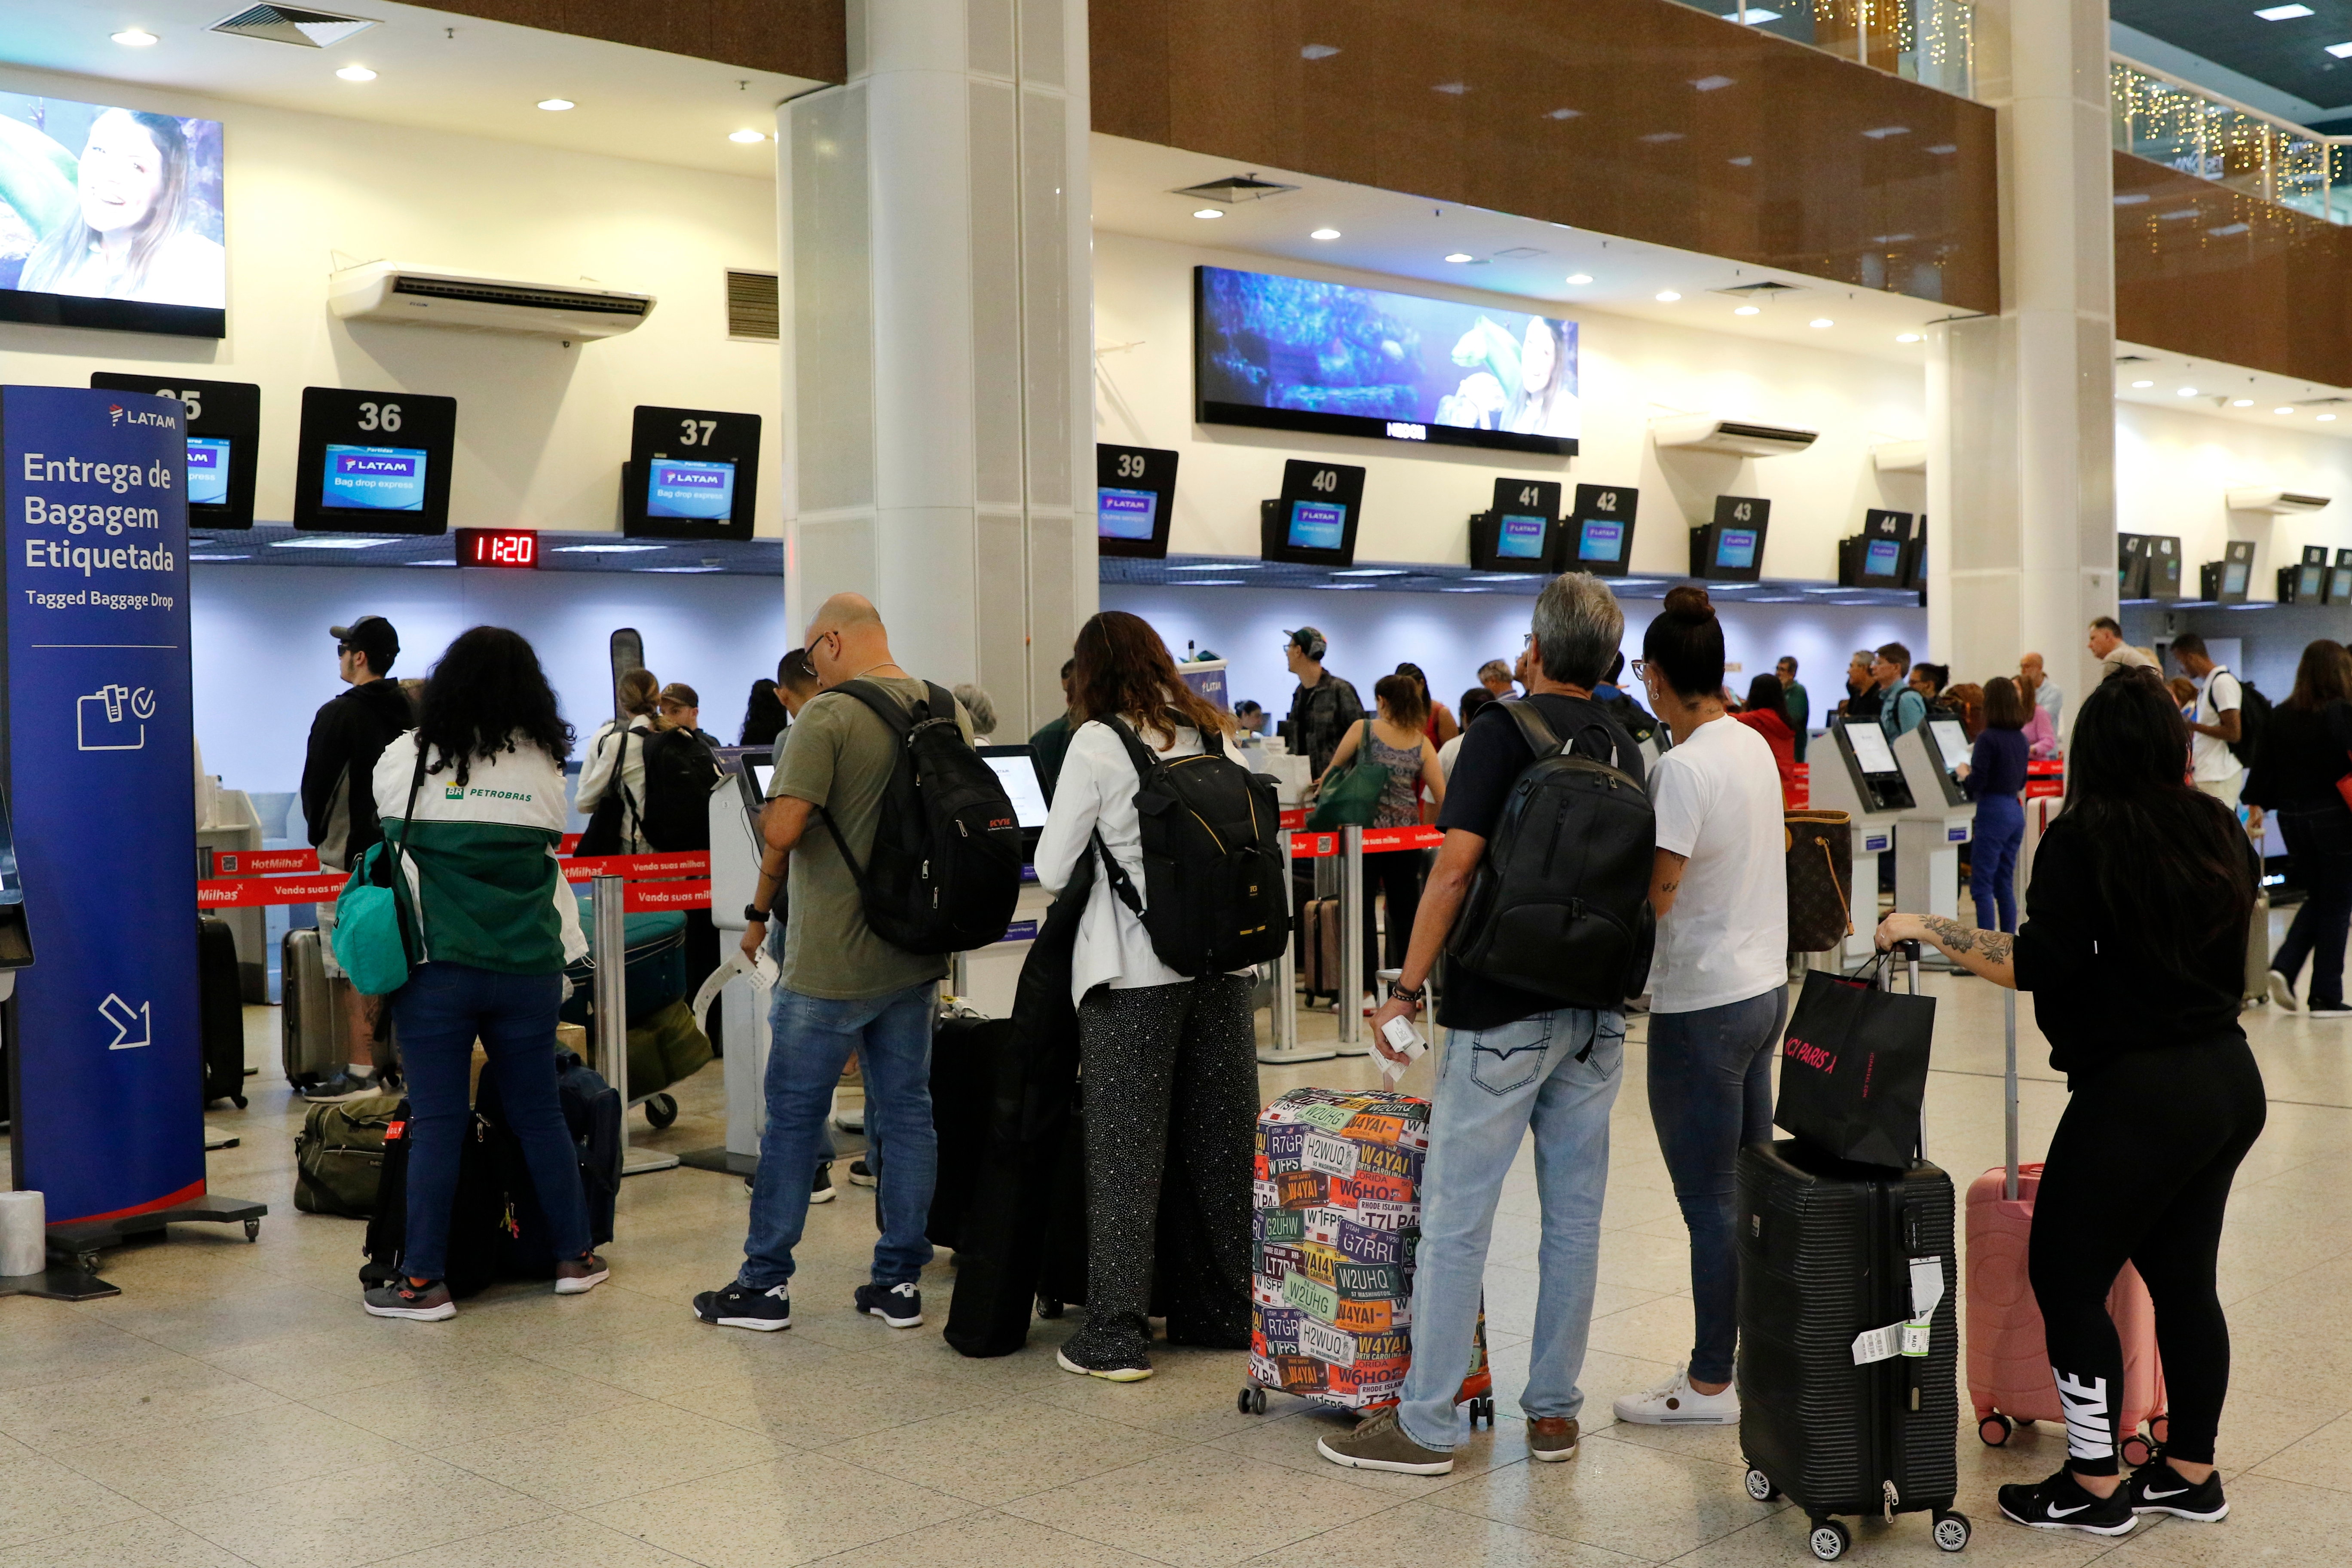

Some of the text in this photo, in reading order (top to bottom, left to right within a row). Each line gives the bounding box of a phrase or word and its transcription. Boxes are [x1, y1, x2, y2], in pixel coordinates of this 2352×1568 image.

[128, 410, 175, 429] LATAM
[358, 402, 401, 432] 36
[680, 419, 717, 446] 37
[24, 453, 171, 494] Entrega de
[358, 461, 407, 471] LATAM
[1118, 454, 1145, 478] 39
[189, 473, 215, 481] press
[334, 478, 353, 487] Bag
[355, 479, 376, 488] drop
[677, 474, 718, 484] LATAM
[1312, 470, 1337, 492] 40
[657, 489, 673, 499] Bag
[1519, 486, 1539, 506] 41
[1597, 492, 1617, 511] 42
[1114, 500, 1145, 508] LATAM
[1733, 503, 1752, 521] 43
[25, 496, 158, 536] Bagagem
[1880, 516, 1897, 533] 44
[26, 539, 174, 576] Etiquetada
[478, 537, 532, 562] 11:20
[26, 590, 173, 610] Tagged Baggage Drop
[470, 789, 532, 802] PETROBRAS
[251, 858, 303, 869] HotMilhas
[565, 867, 603, 878] tMilhas
[633, 863, 658, 872] Venda
[680, 860, 705, 868] milhas
[198, 889, 238, 901] Milhas
[274, 885, 305, 895] Venda
[331, 882, 347, 892] mil
[638, 892, 669, 902] Venda
[695, 890, 710, 900] mil
[1785, 1037, 1830, 1069] ICI PARIS
[1306, 1106, 1344, 1124] W2UHG
[1307, 1138, 1344, 1166] H2WUQ
[1361, 1144, 1409, 1174] W4YAI
[1357, 1161, 1371, 1172] ORTH
[1355, 1173, 1387, 1183] LORIDA
[1288, 1179, 1318, 1200] W4YAI
[1342, 1200, 1358, 1208] SUNS
[1361, 1201, 1403, 1212] RHODE ISLAND
[1267, 1217, 1298, 1236] G2UHW
[1345, 1223, 1399, 1243] UTAH 1950
[1344, 1233, 1399, 1264] G7RRL
[1310, 1269, 1332, 1283] CAROLINA
[1339, 1268, 1389, 1290] W2UHQ
[1305, 1280, 1317, 1292] N.J.
[1291, 1281, 1329, 1314] W2UHG
[1304, 1324, 1341, 1355] H2WUQ
[1359, 1335, 1407, 1354] W4YAI
[1356, 1352, 1370, 1360] ORTH
[1288, 1366, 1317, 1384] W4YAI
[1362, 1380, 1405, 1393] RHODE ISLAN
